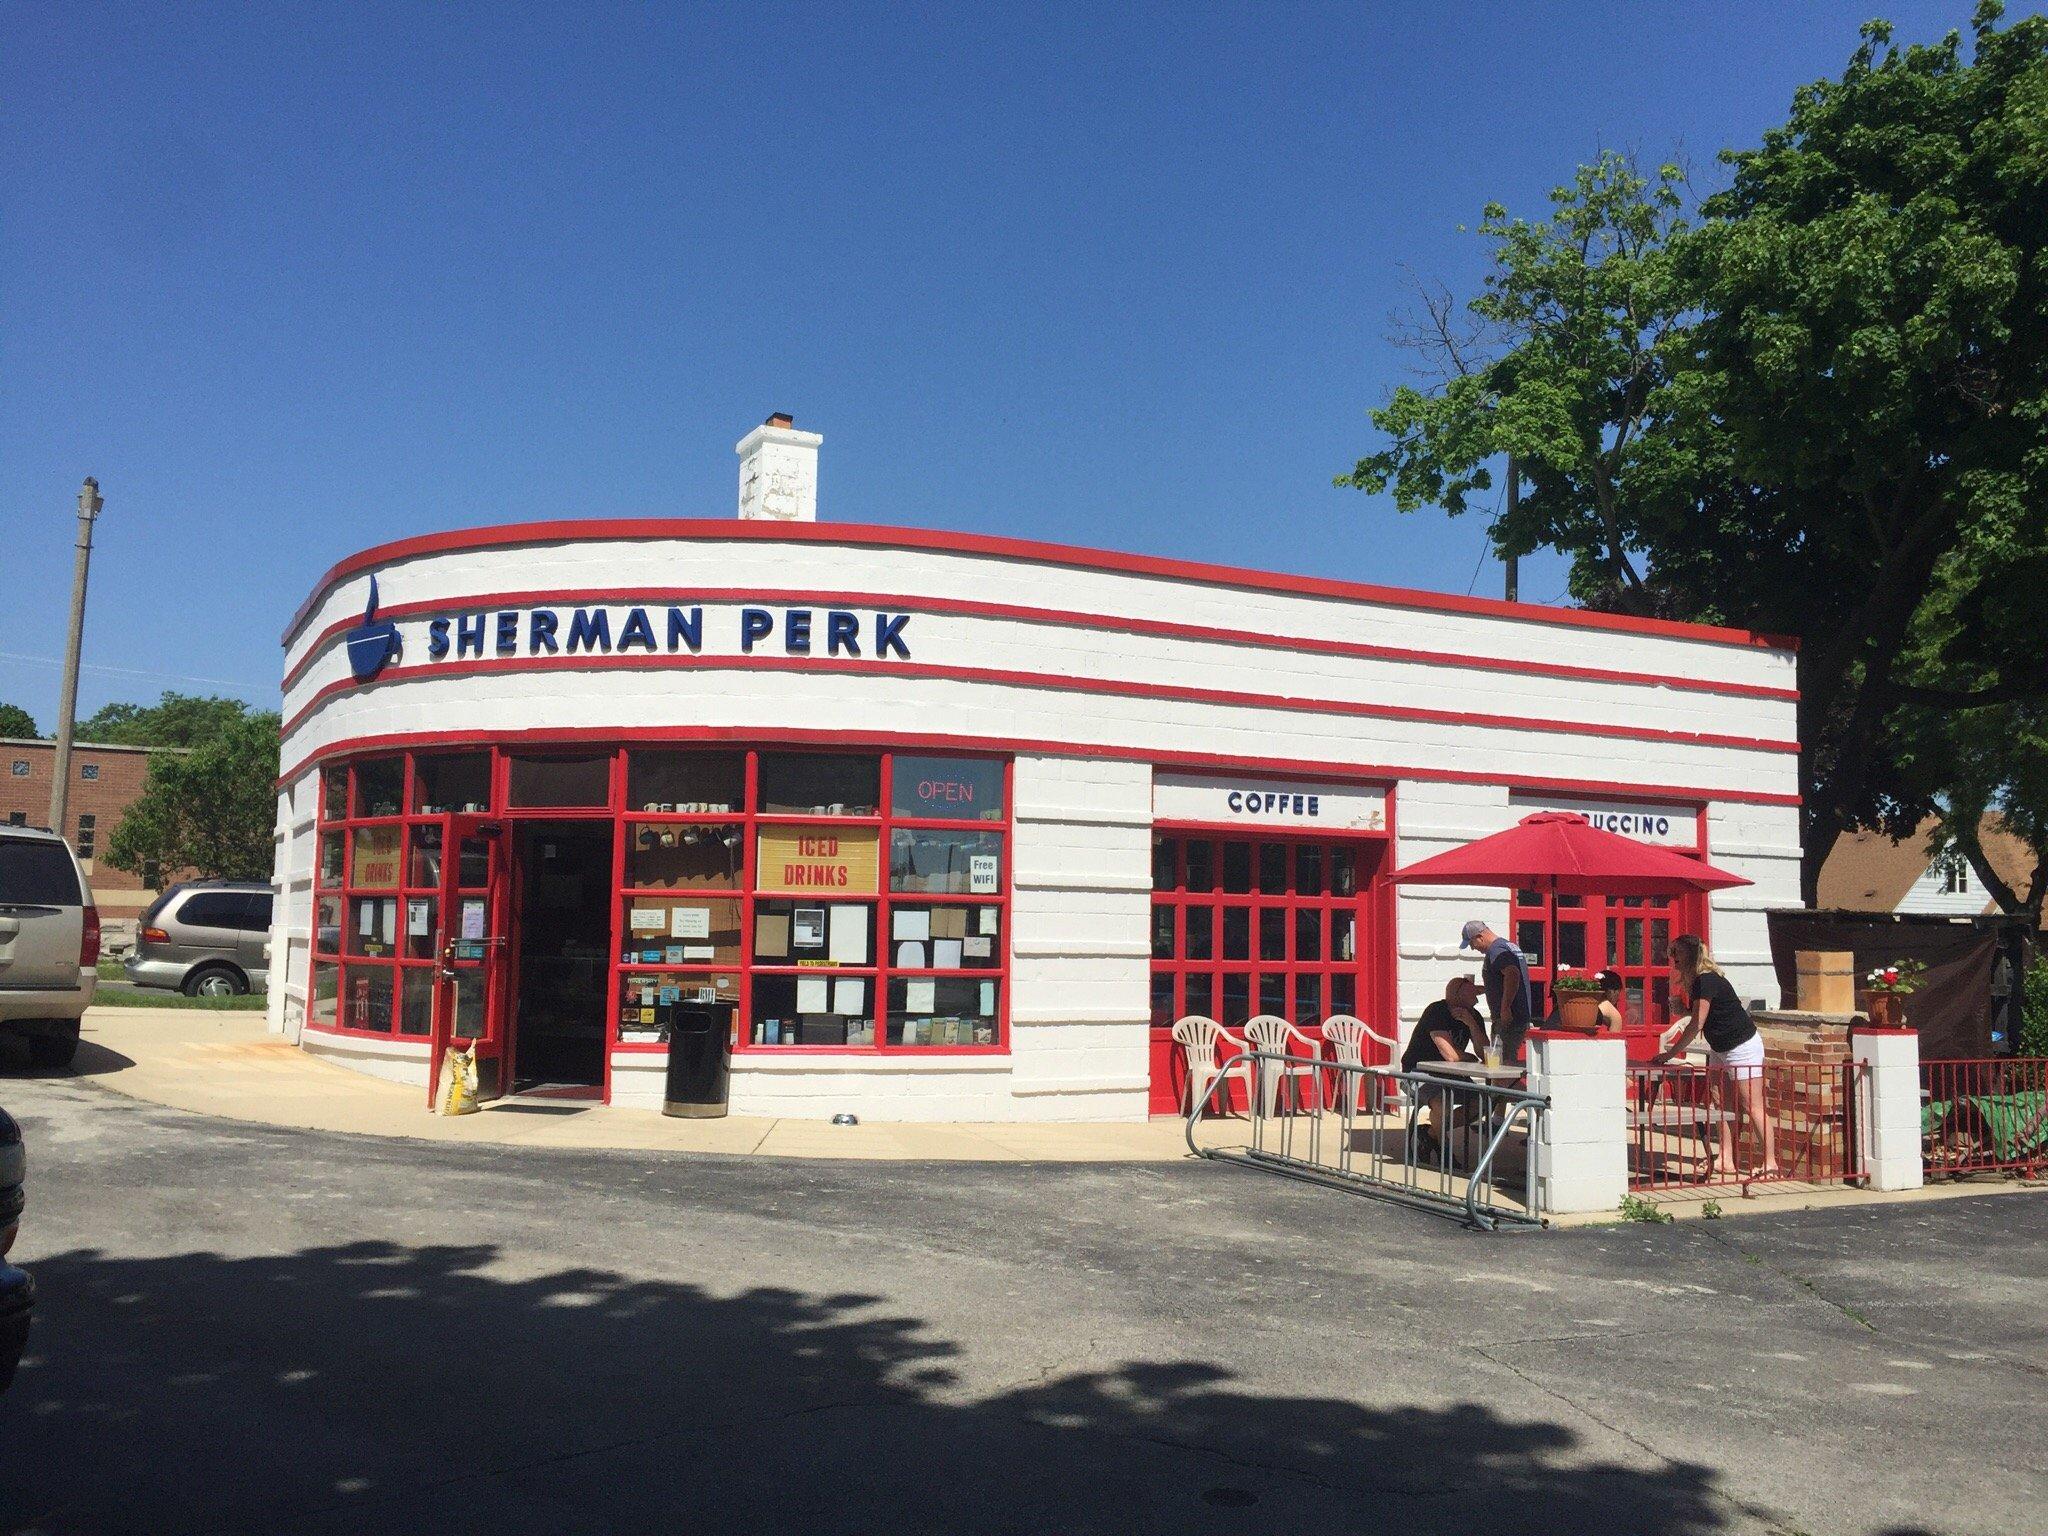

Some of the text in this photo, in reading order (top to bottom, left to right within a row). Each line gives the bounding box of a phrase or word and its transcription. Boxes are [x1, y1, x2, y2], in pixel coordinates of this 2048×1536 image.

[428, 607, 911, 661] SHERMAN PERK
[918, 780, 974, 802] OPEN
[1228, 792, 1319, 816] COFFEE
[1581, 812, 1669, 836] UCCINO
[798, 836, 838, 857] ICED
[784, 864, 848, 887] DRINKS
[974, 859, 994, 870] Free
